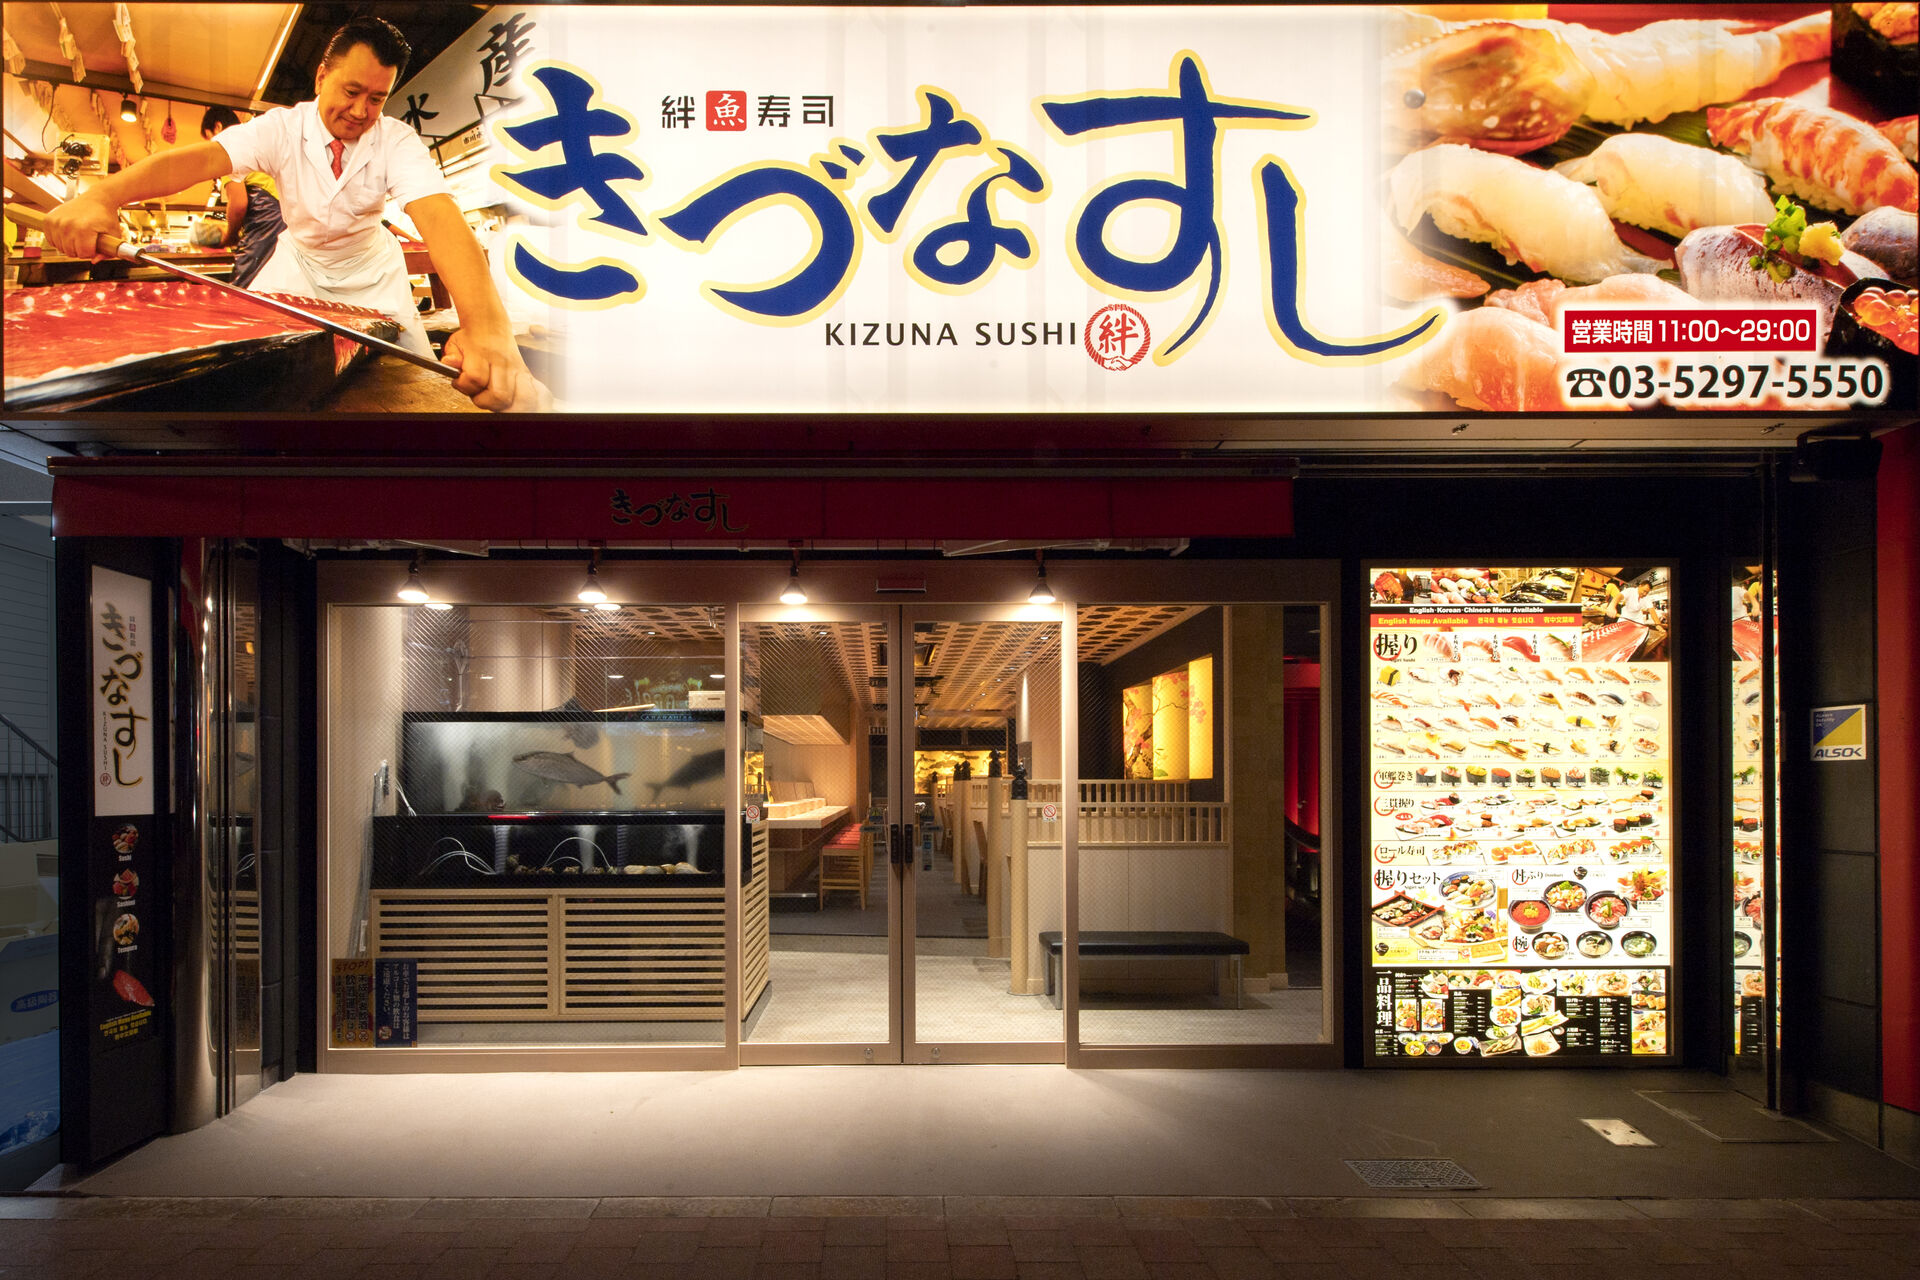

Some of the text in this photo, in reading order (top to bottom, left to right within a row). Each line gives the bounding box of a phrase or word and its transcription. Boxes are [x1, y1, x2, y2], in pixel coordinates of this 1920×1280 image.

[500, 56, 1440, 358] きづなすし
[825, 322, 1076, 346] KIZUNA SUSHI
[1571, 319, 1653, 344] 営業時間
[1608, 364, 1884, 399] 03-5297-5550
[611, 488, 748, 533] きづなすし
[1378, 617, 1407, 627] English
[1376, 633, 1418, 656] 握り
[100, 602, 148, 787] きづなすし
[1814, 747, 1862, 759] ALSOK
[1376, 869, 1441, 887] 握りセット
[1376, 970, 1393, 1027] 一品料理
